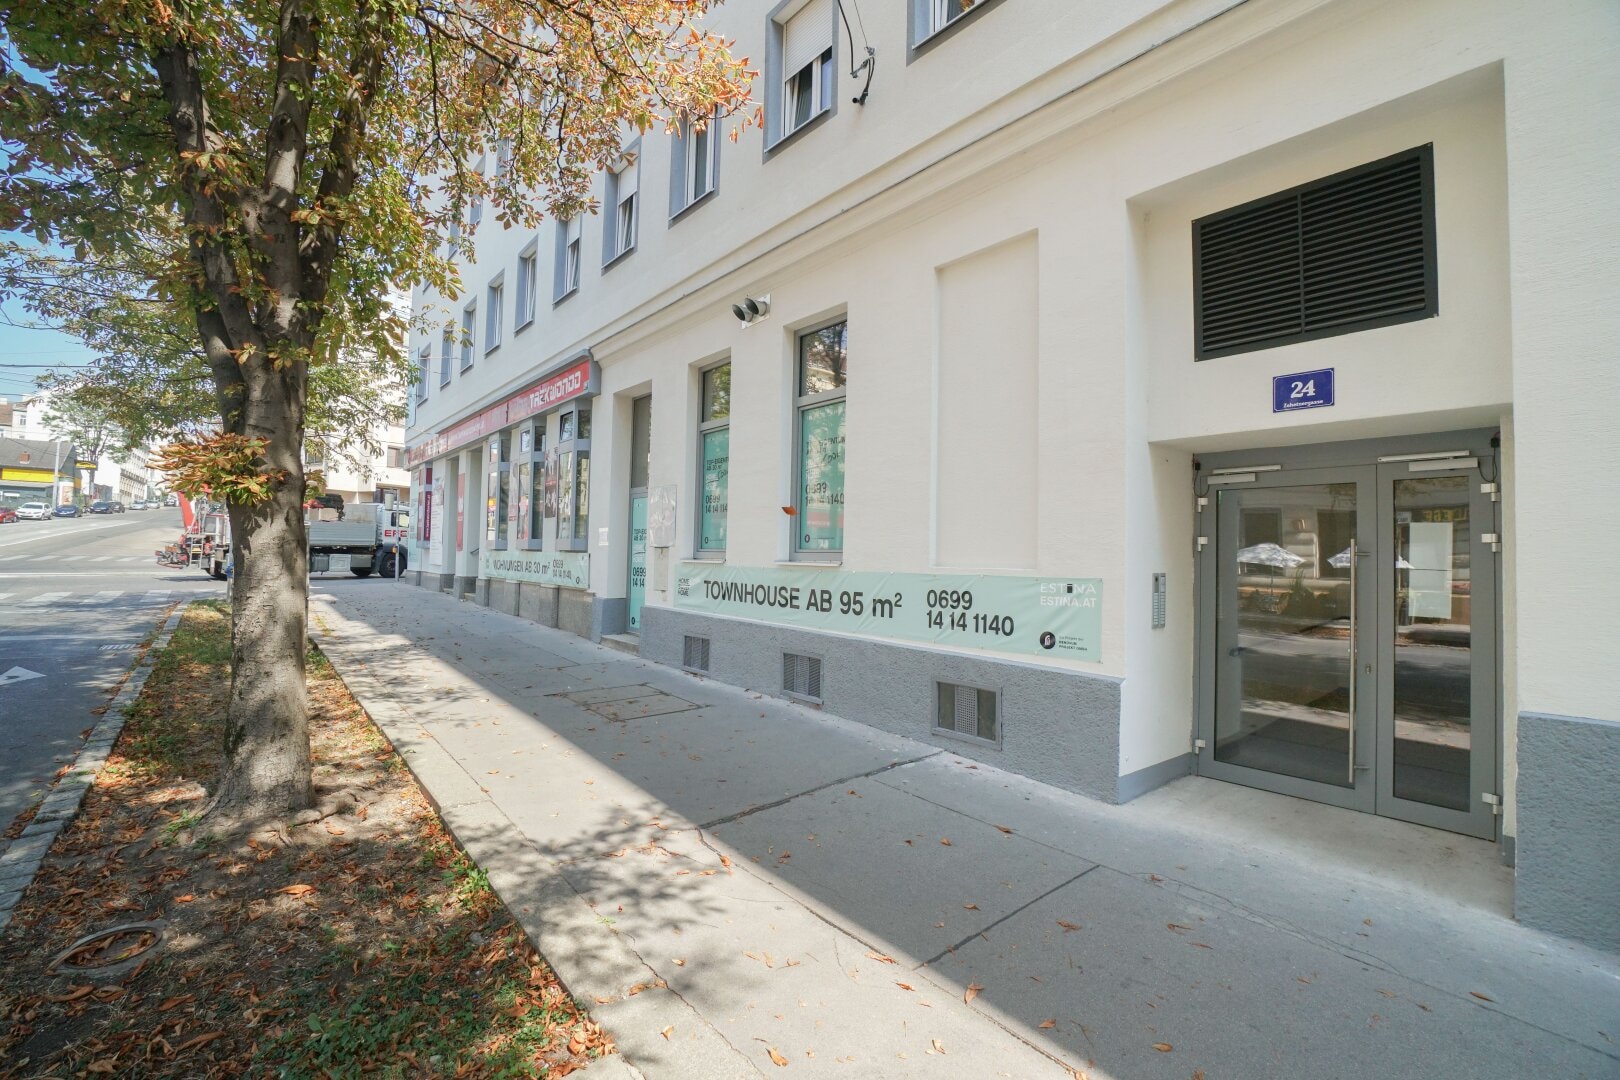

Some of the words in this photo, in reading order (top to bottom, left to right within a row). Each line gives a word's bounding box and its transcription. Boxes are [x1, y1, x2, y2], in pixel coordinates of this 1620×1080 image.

[1290, 379, 1316, 398] 24
[493, 560, 524, 572] WOHNUNGEN
[525, 562, 533, 574] AB
[534, 562, 541, 575] 30
[704, 580, 800, 610] TOWNHOUSE
[806, 589, 832, 613] AB
[839, 590, 864, 616] 95
[872, 592, 903, 619] m²
[926, 589, 973, 610] 0699
[1040, 596, 1097, 609] ESTINA.AT
[926, 610, 943, 630] 14
[949, 611, 967, 632] 14
[973, 613, 1015, 637] 1140
